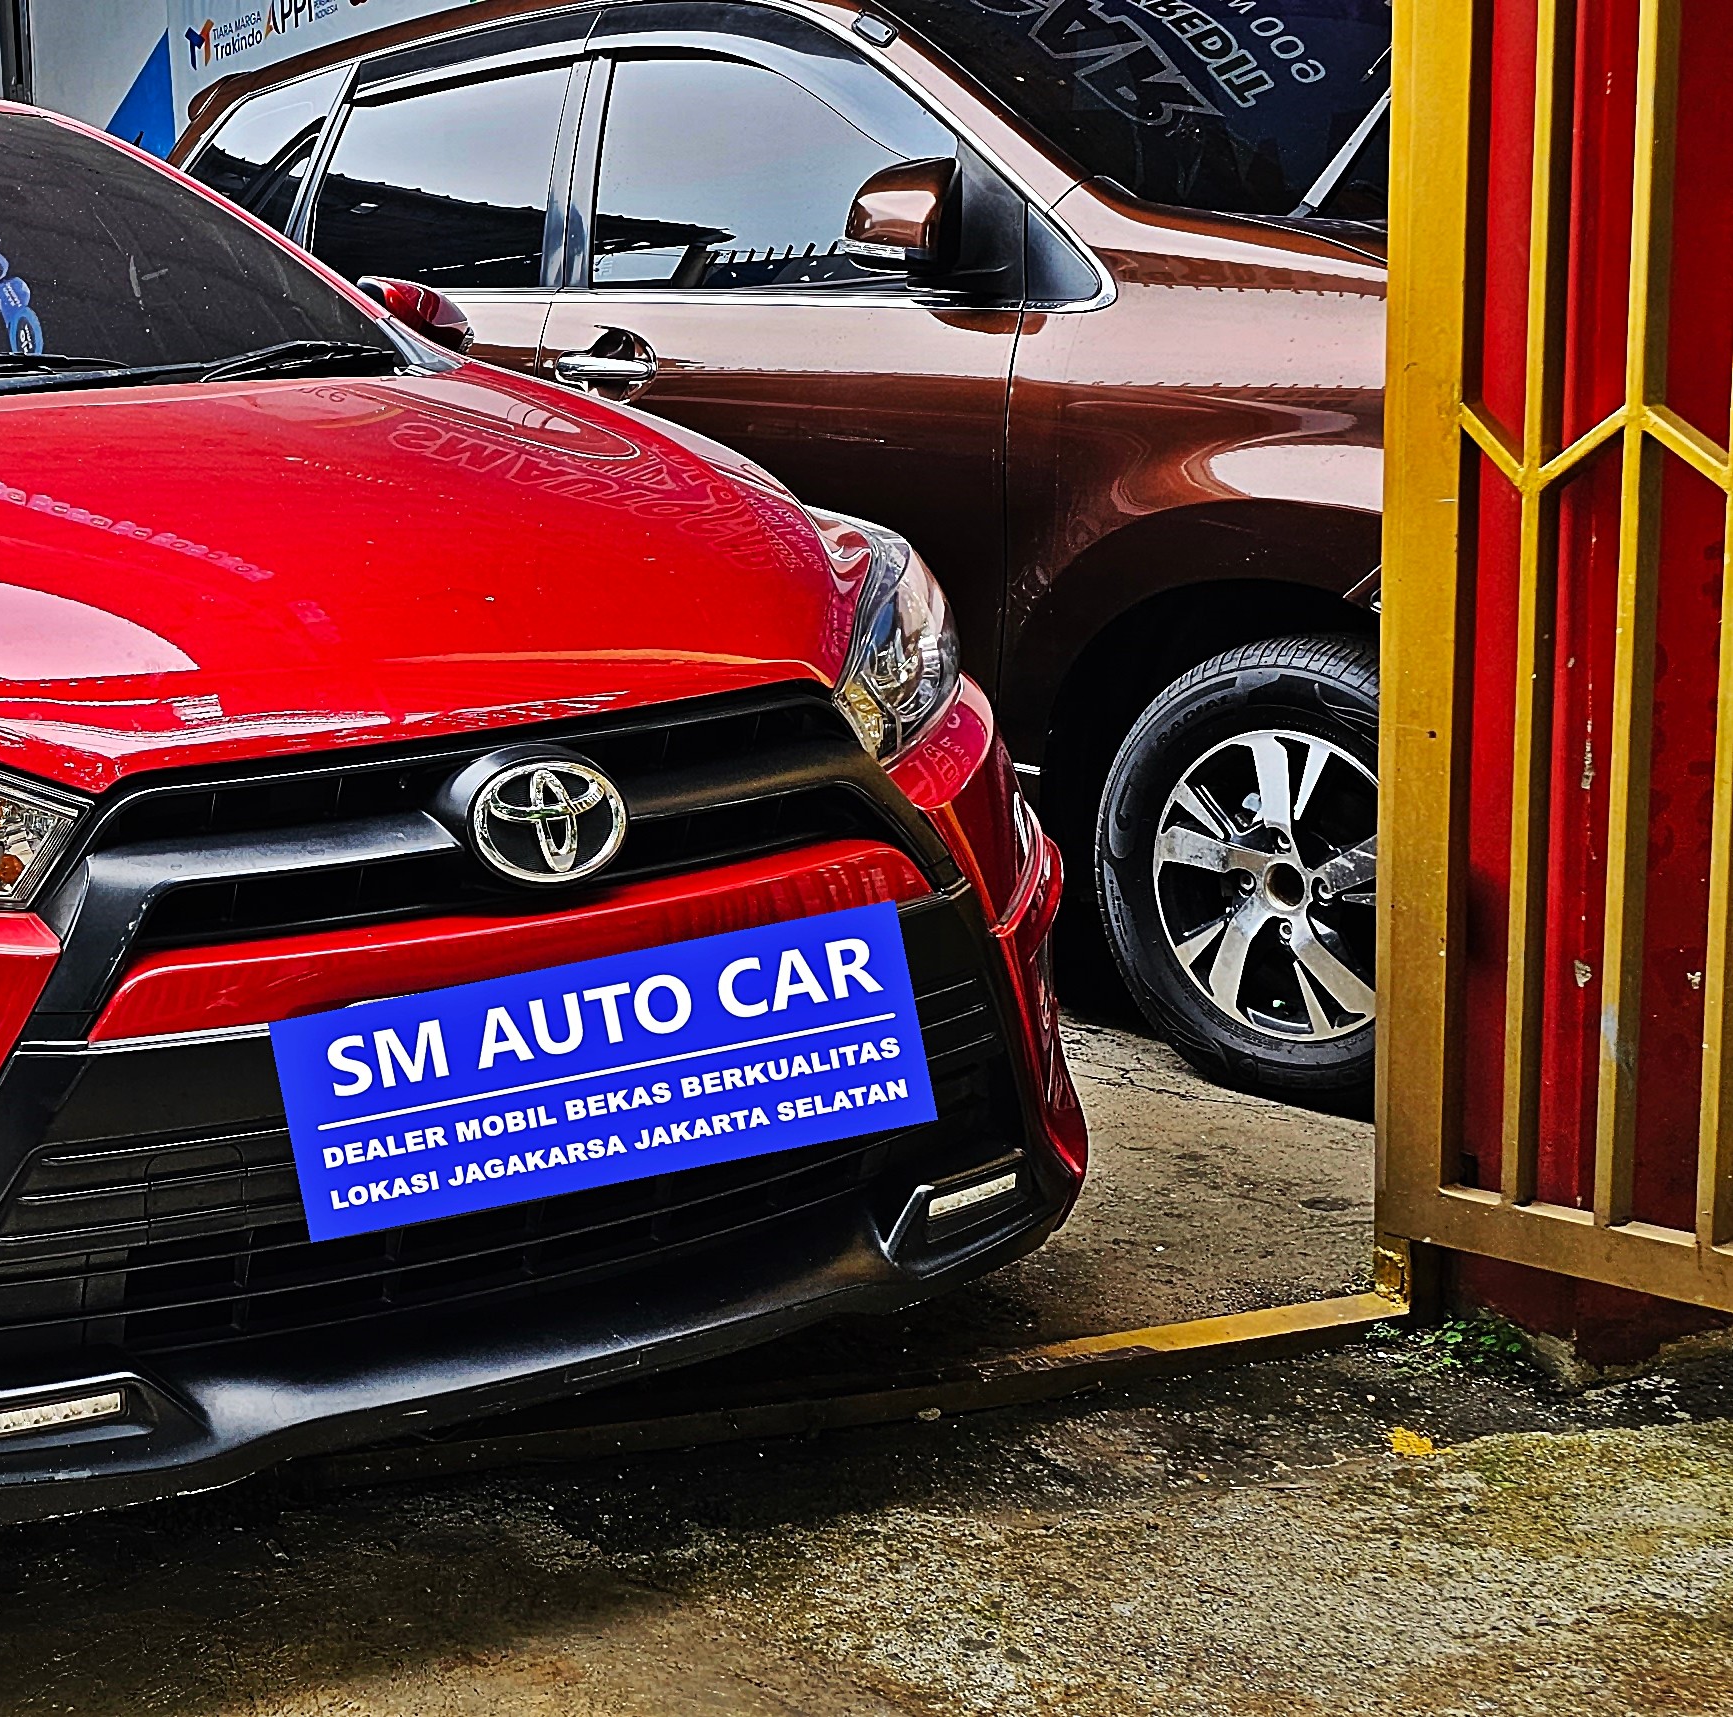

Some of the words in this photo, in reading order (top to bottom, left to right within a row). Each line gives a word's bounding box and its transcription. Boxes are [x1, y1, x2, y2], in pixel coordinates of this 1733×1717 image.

[212, 23, 234, 41] TIARA
[234, 10, 262, 34] MARGA
[213, 27, 264, 62] Trakindo
